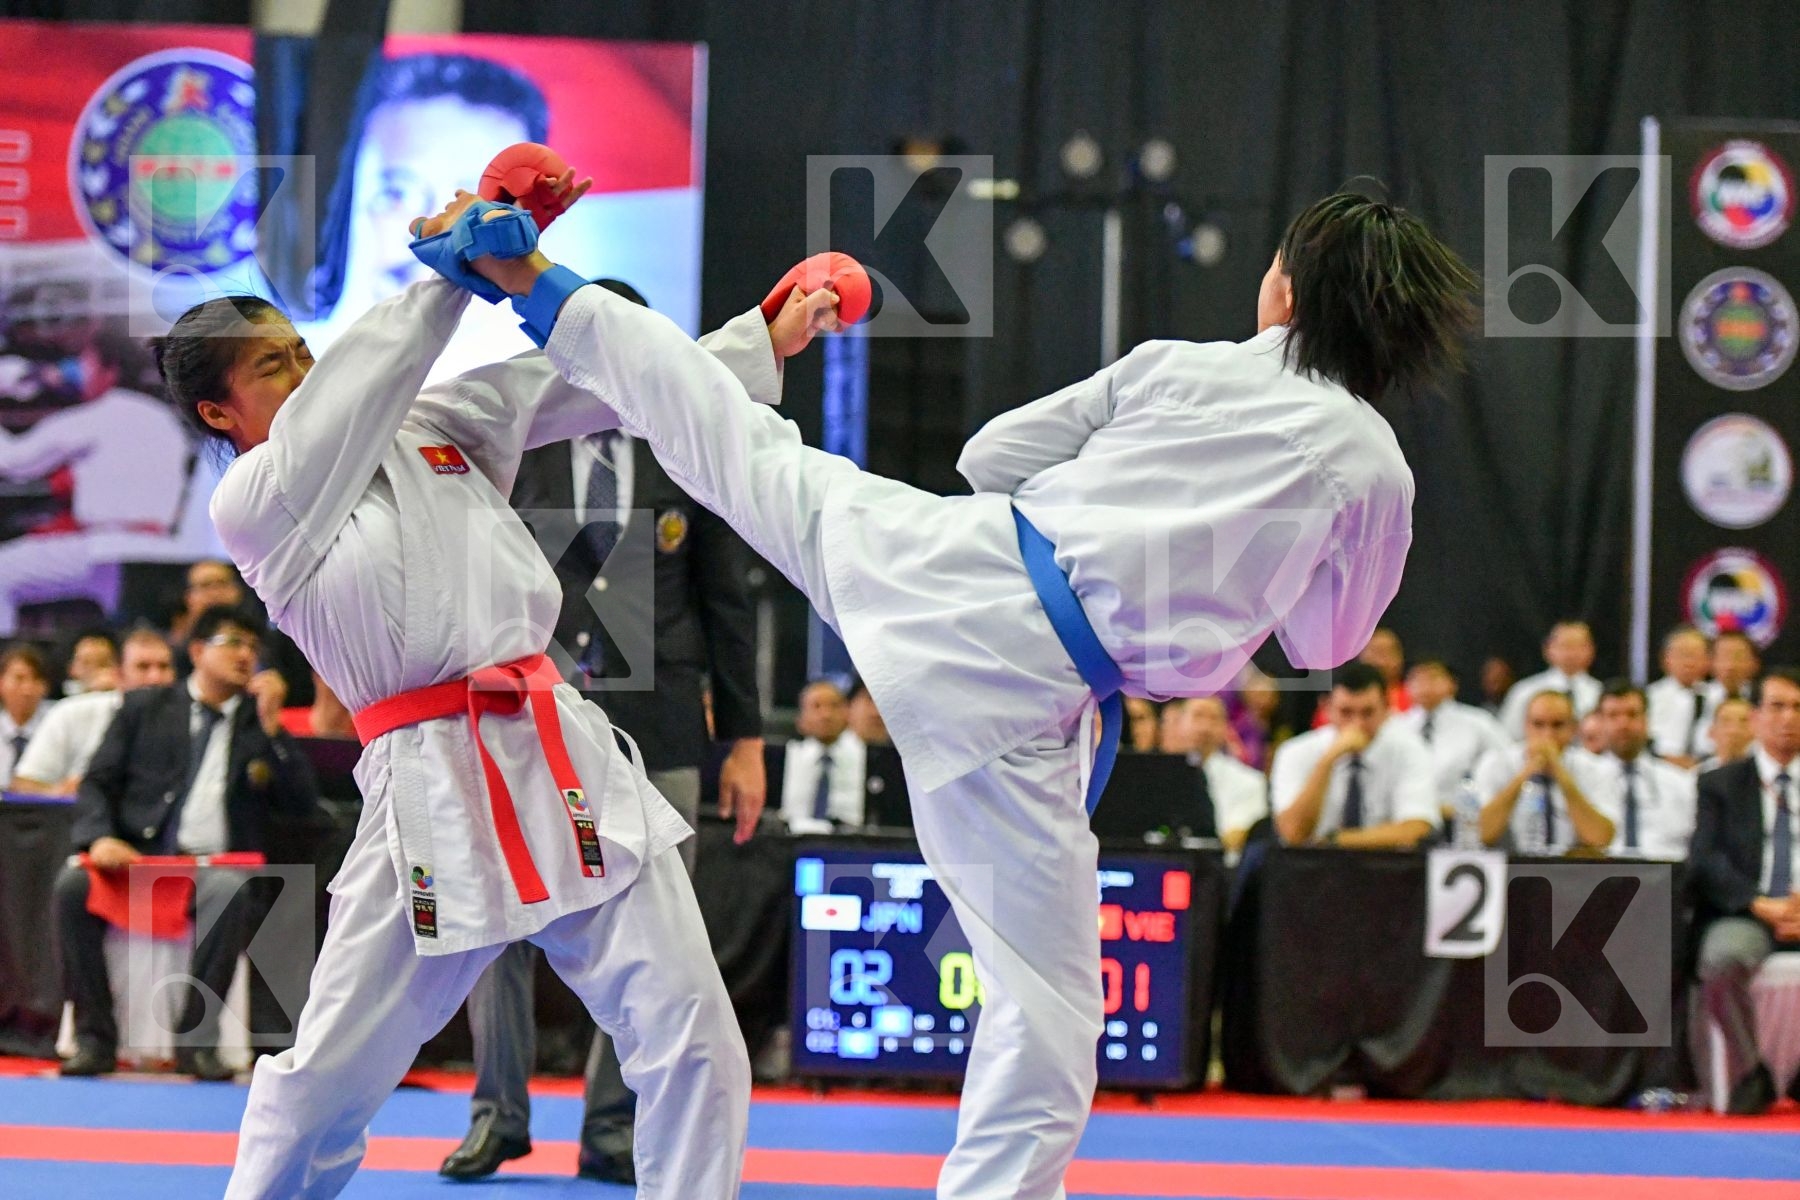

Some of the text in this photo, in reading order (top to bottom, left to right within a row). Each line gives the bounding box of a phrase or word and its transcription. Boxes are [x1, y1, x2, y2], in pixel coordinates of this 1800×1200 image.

[861, 902, 923, 933] JPN
[1124, 911, 1175, 942] VIE
[1441, 863, 1486, 942] 2
[830, 949, 893, 1006] 02
[1100, 957, 1150, 1015] 01
